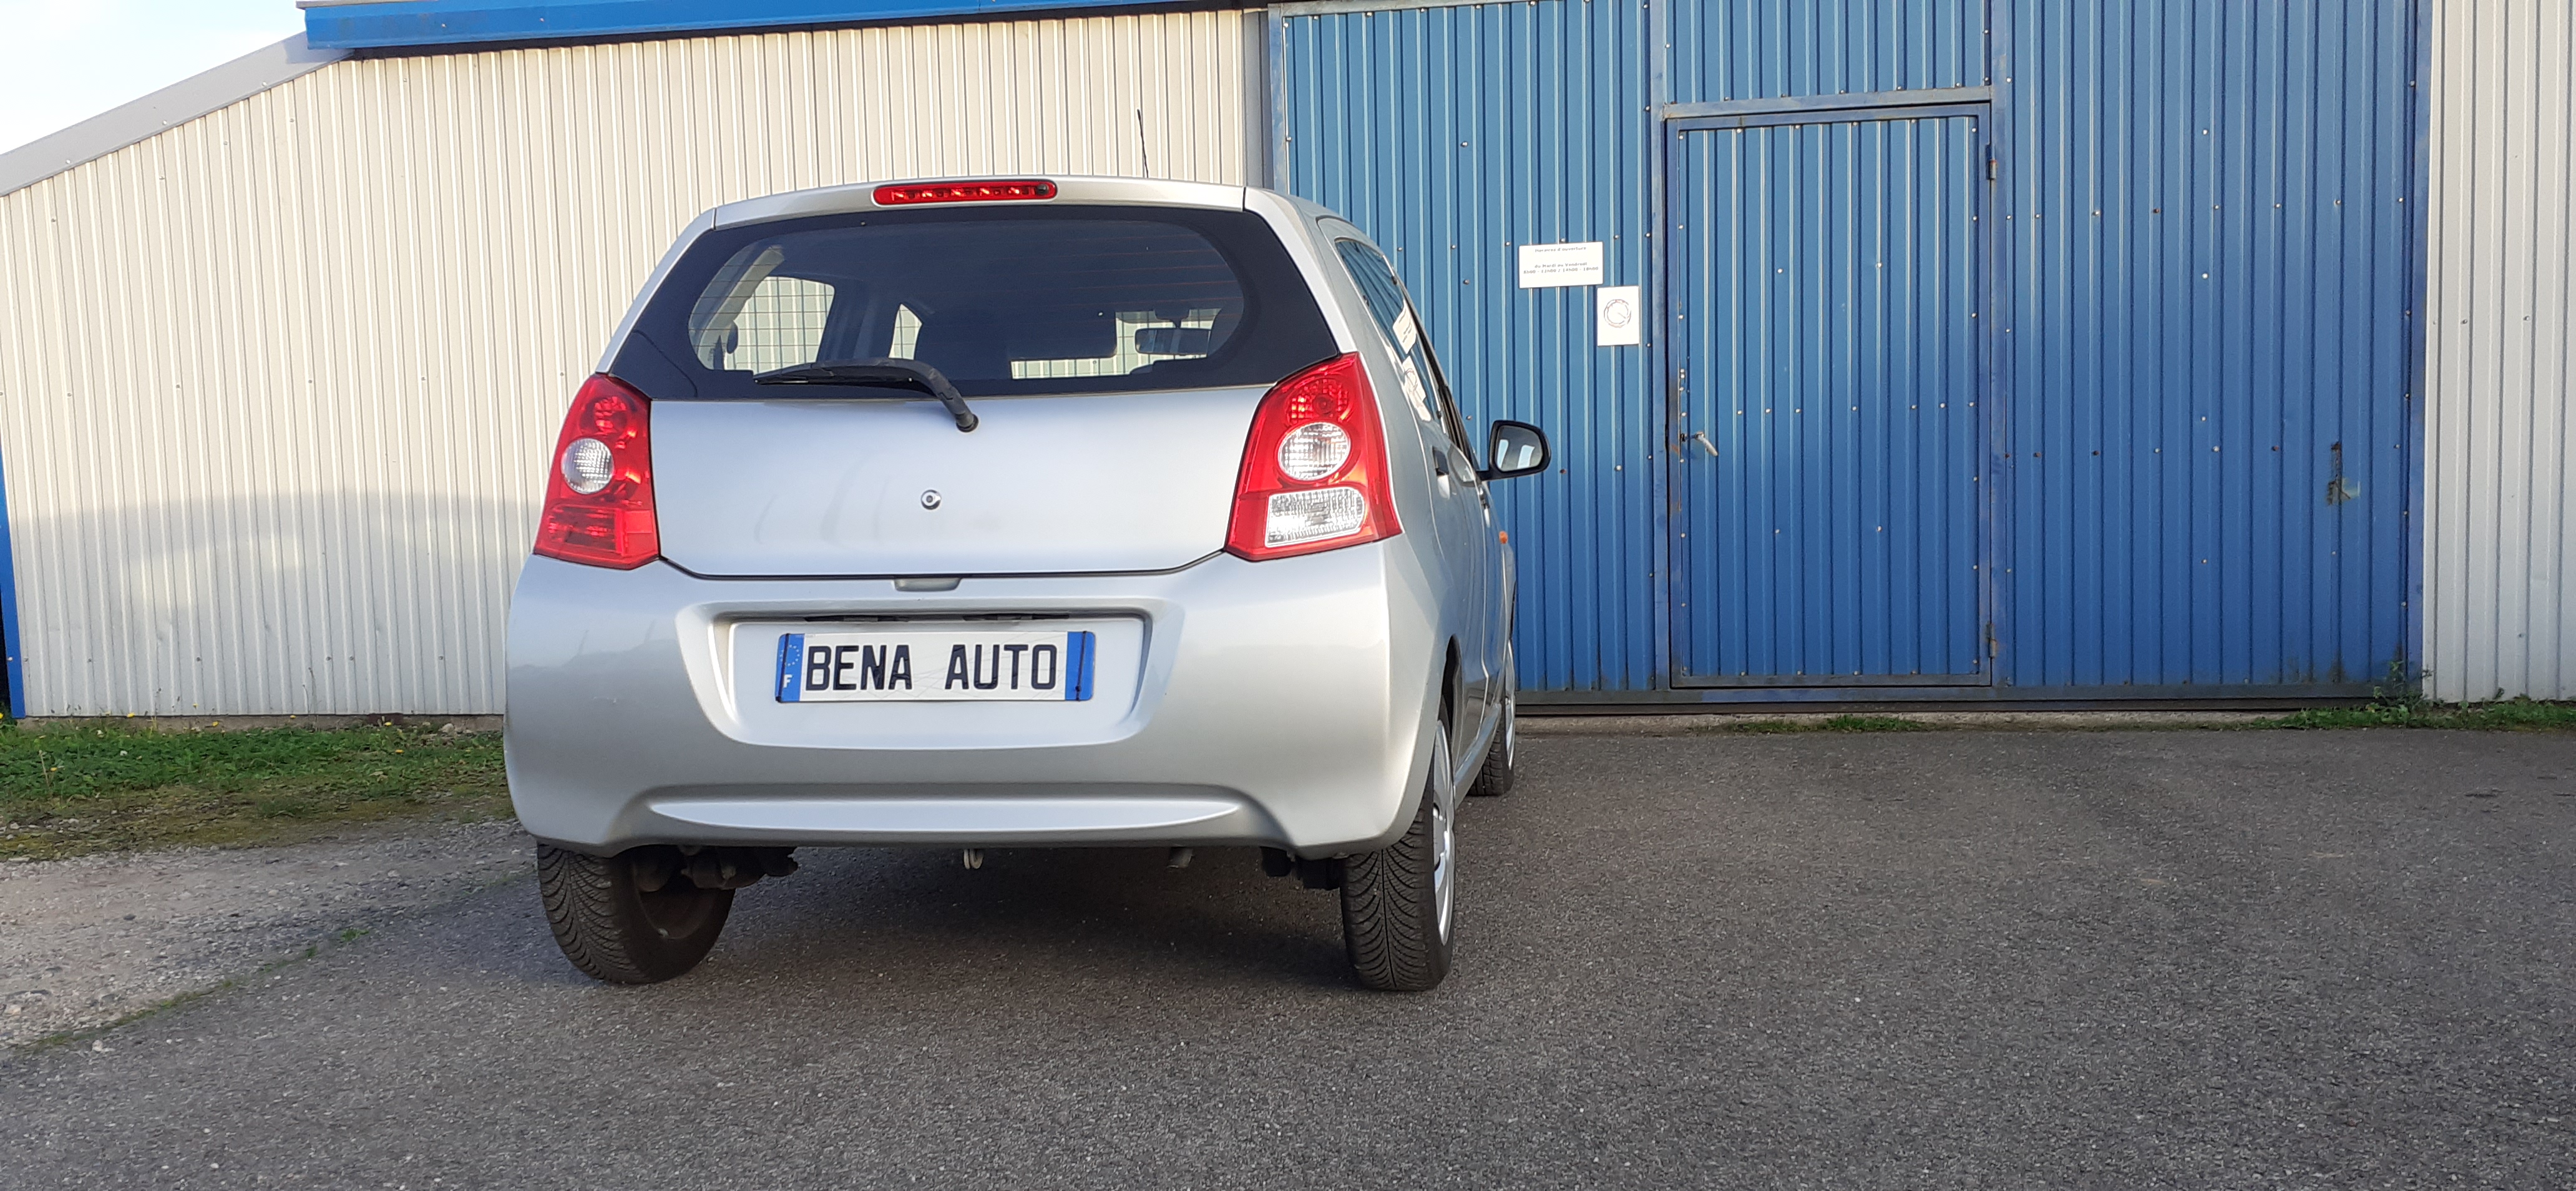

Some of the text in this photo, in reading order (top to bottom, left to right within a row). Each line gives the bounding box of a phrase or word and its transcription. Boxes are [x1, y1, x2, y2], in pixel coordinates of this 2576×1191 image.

[784, 674, 793, 688] F
[806, 644, 1058, 691] BENA AUTO
